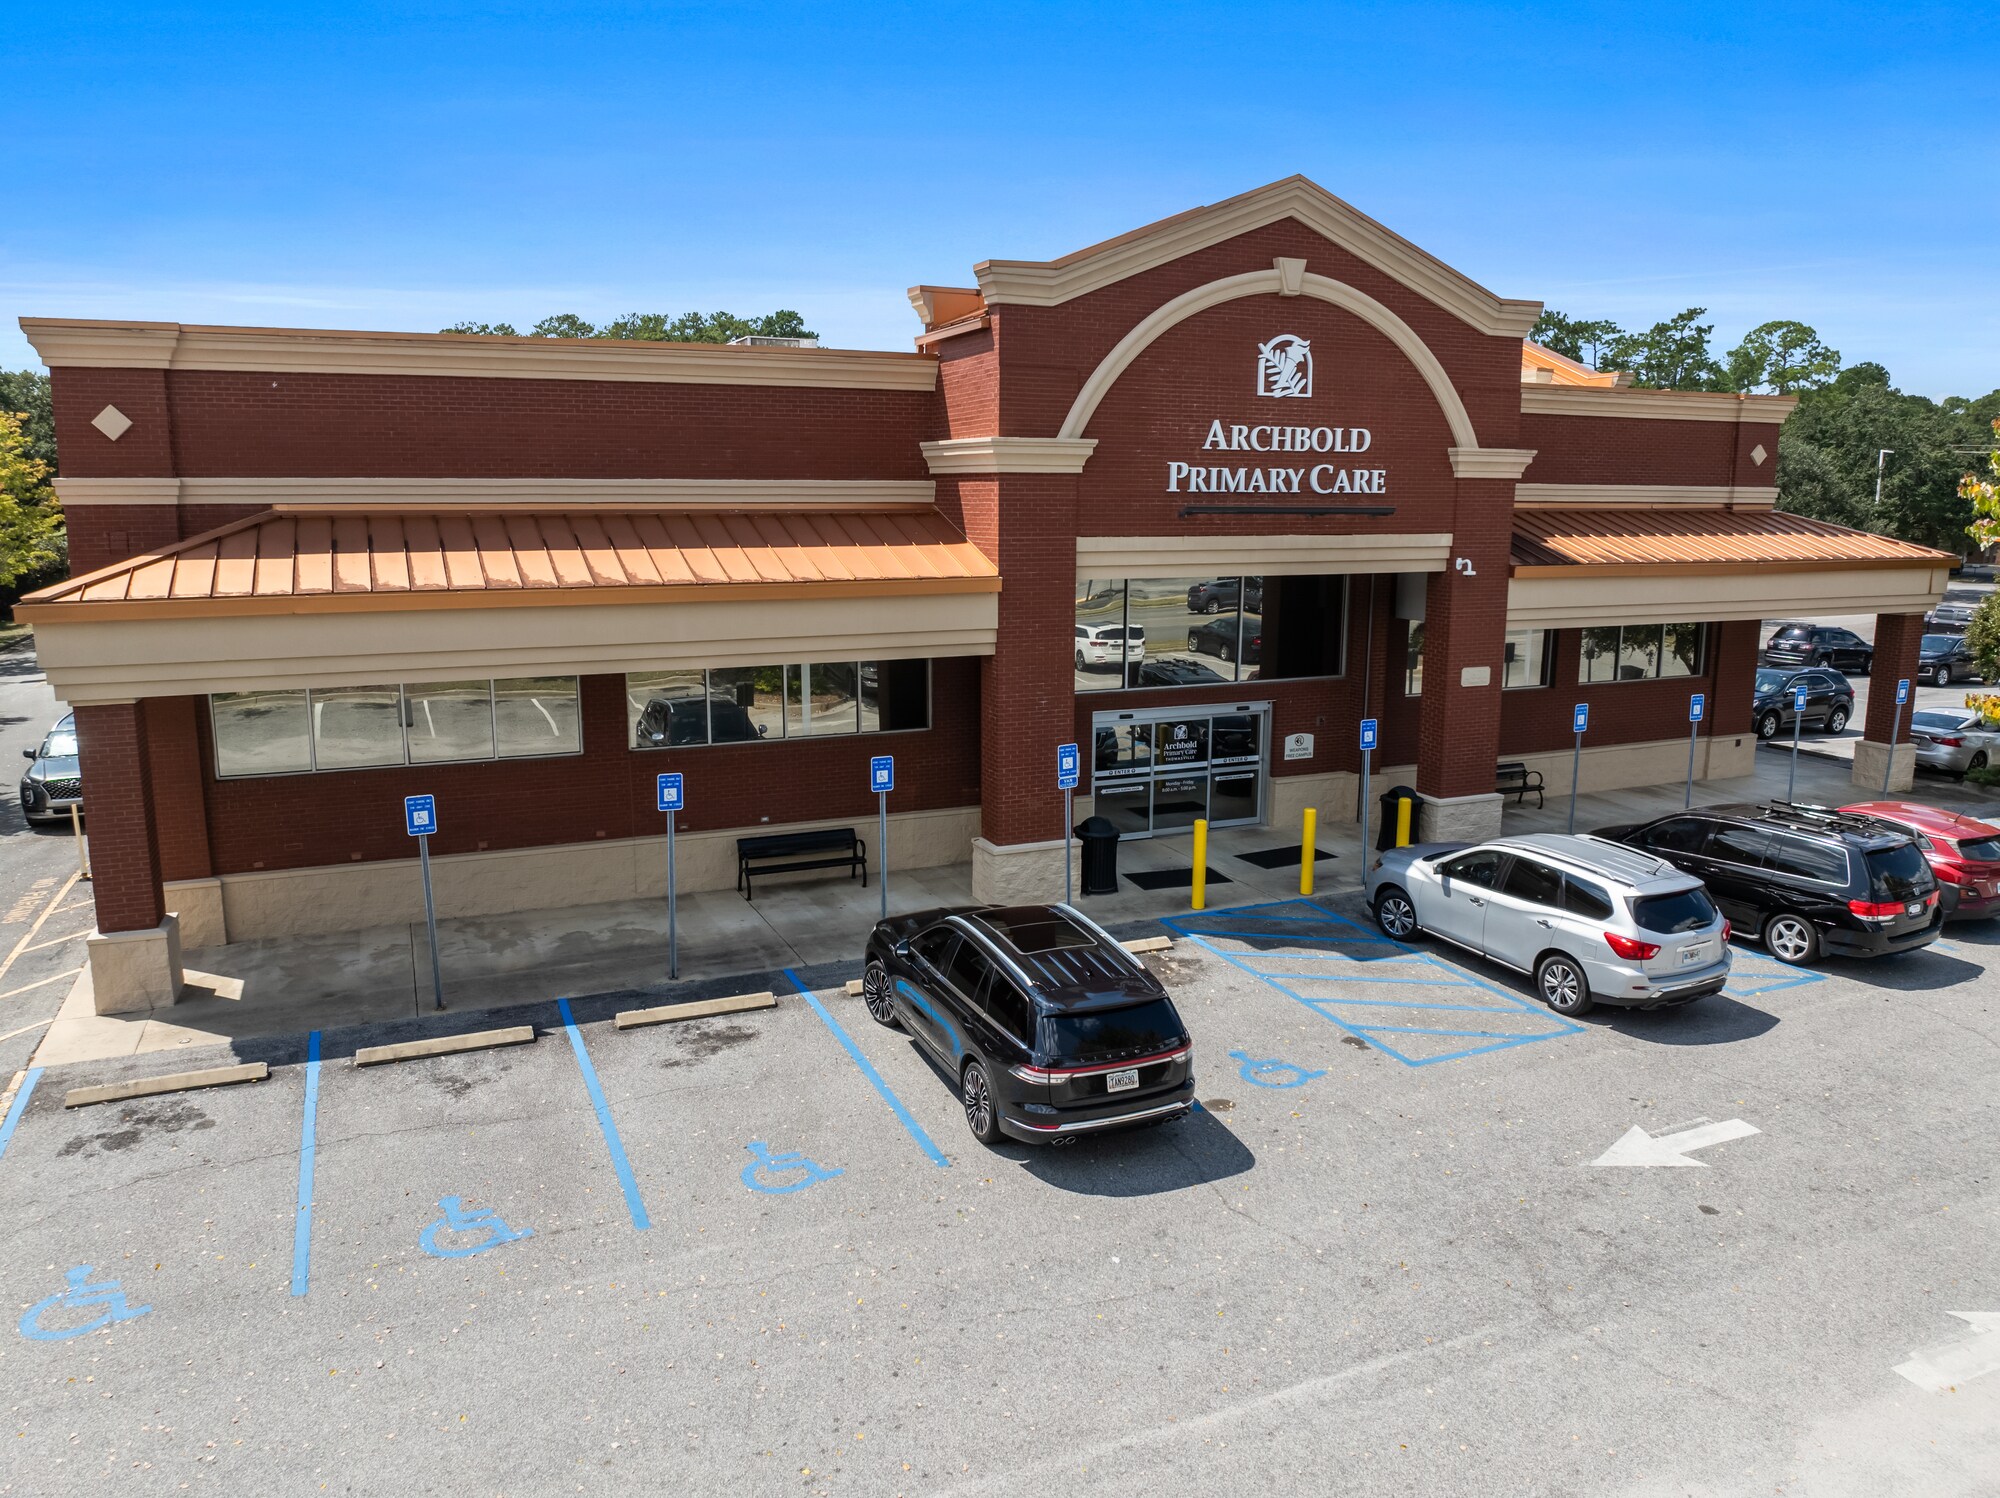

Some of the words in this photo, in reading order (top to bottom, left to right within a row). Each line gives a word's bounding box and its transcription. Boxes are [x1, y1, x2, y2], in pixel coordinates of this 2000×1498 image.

[1201, 419, 1372, 453] ARCHBOLD
[1166, 461, 1306, 493] PRIMARY
[1309, 463, 1387, 494] CARE
[1163, 740, 1198, 751] Archbold
